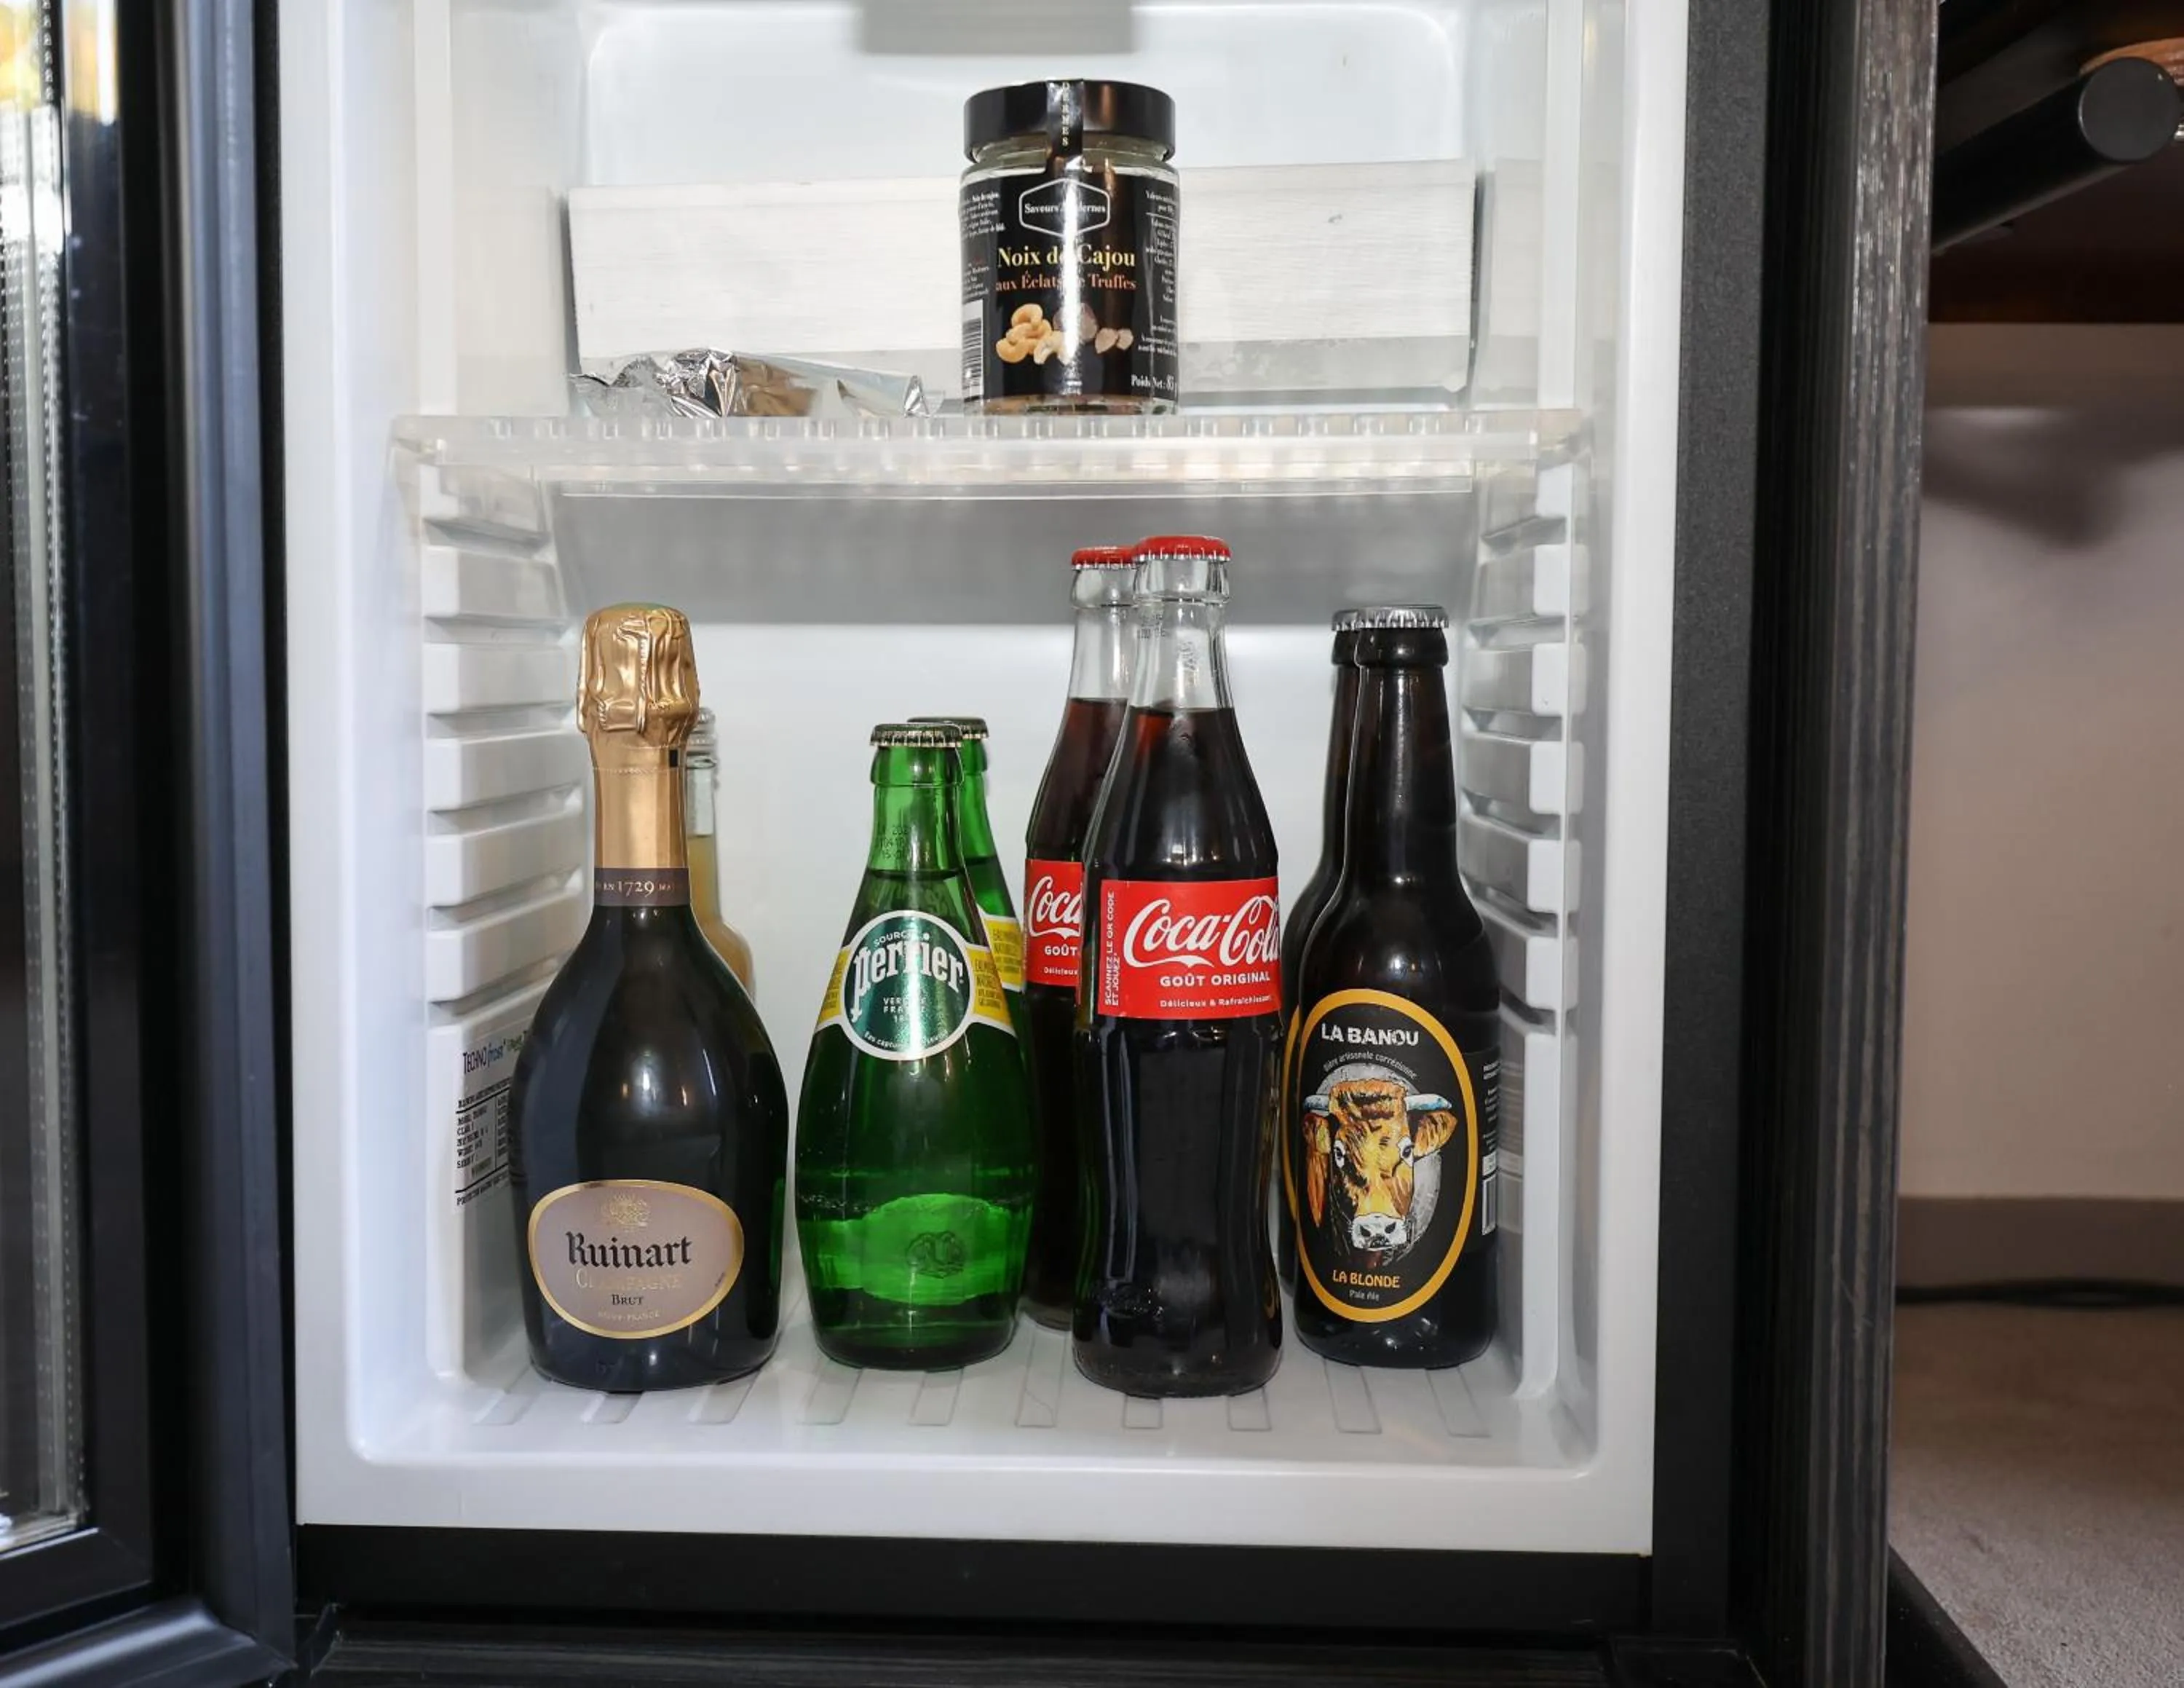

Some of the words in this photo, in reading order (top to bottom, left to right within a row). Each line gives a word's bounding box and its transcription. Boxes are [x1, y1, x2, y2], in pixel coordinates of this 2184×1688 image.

[1024, 203, 1059, 214] Saveurs
[997, 245, 1041, 268] Noix
[1077, 244, 1136, 272] Cajou
[996, 280, 1017, 291] aux
[1088, 273, 1137, 290] Truffes
[618, 880, 654, 897] 1729
[1107, 891, 1115, 921] CODE
[1123, 895, 1278, 968] Coca-Cola
[1044, 944, 1078, 956] GOÛT
[1105, 940, 1113, 953] LE
[1104, 956, 1113, 1006] SCANNEZ
[1160, 973, 1206, 987] GOÛT
[1211, 971, 1270, 985] ORIGINAL
[1112, 993, 1119, 1006] ET
[1160, 998, 1206, 1007] Délicieux
[1209, 998, 1216, 1006] &
[1321, 1022, 1344, 1042] LA
[1348, 1027, 1419, 1046] BANOU
[1340, 1051, 1374, 1062] artisanale
[566, 1231, 692, 1269] Ruinart
[1332, 1269, 1348, 1284] LA
[1350, 1272, 1401, 1288] BLONDE
